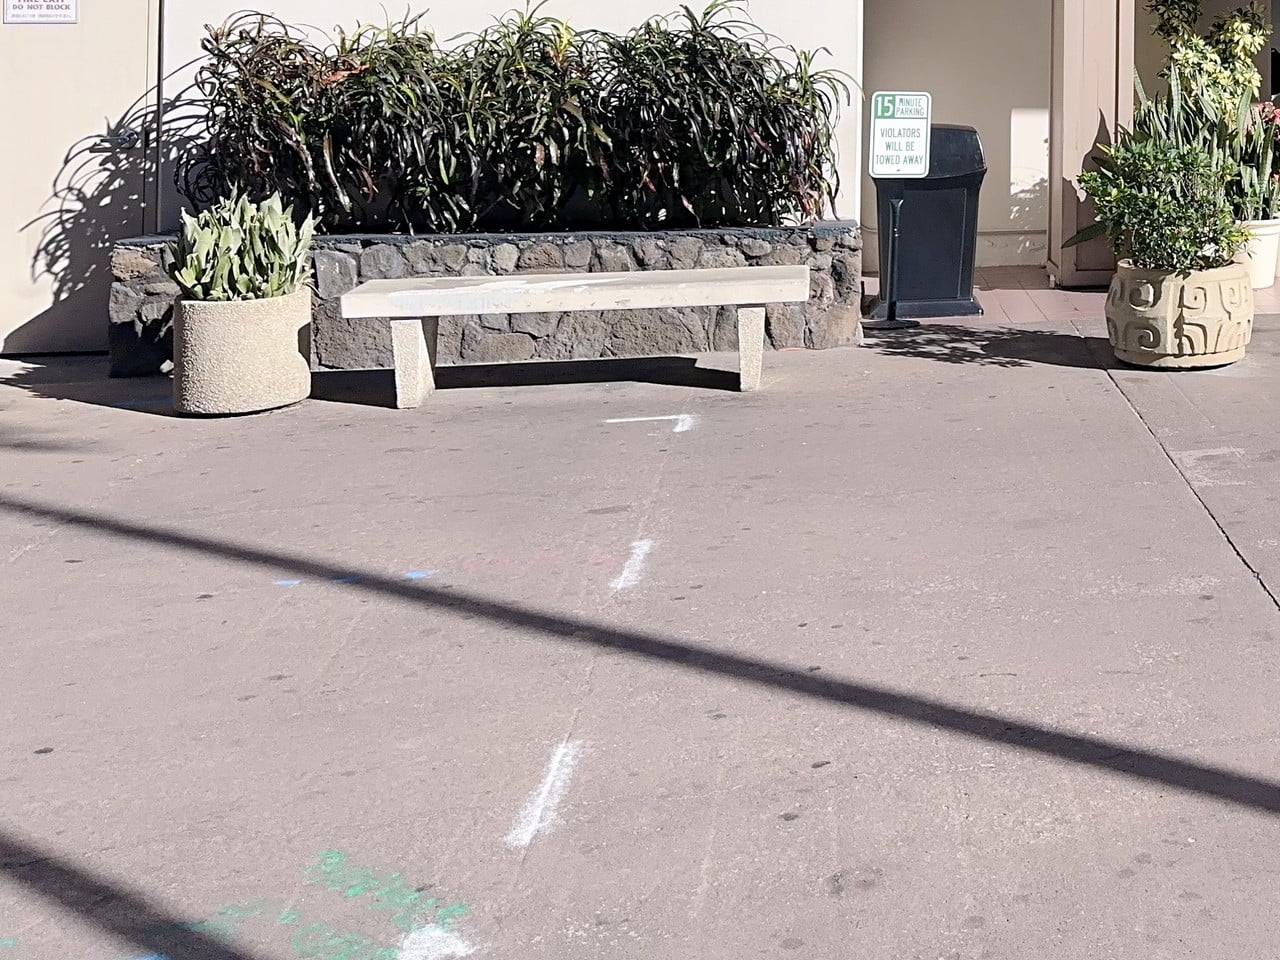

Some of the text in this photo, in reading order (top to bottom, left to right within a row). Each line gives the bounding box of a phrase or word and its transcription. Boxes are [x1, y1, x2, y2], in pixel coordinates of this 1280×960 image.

[876, 95, 922, 117] 15 MINUTE
[896, 107, 925, 116] PARKING
[880, 128, 921, 138] VIOLATORS
[885, 141, 915, 152] WILL BE
[876, 154, 924, 165] TOWED AWAY
